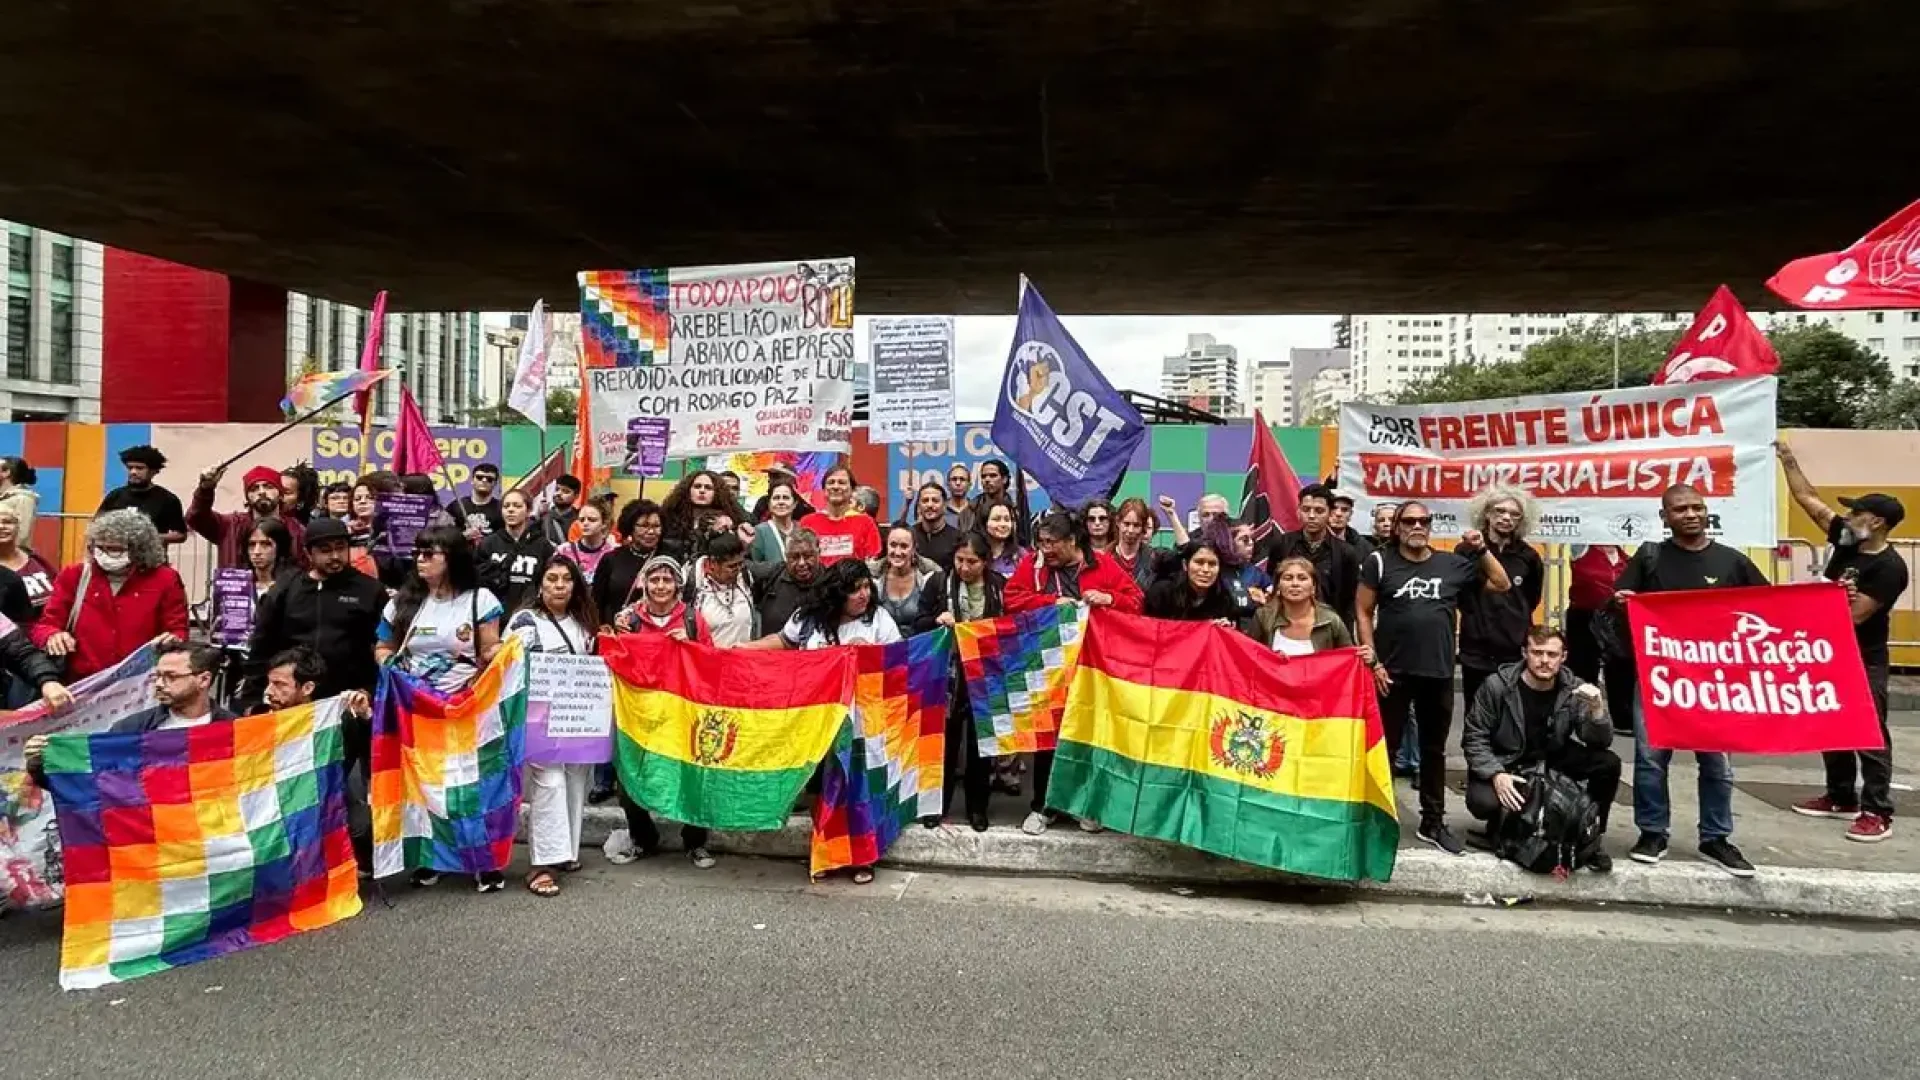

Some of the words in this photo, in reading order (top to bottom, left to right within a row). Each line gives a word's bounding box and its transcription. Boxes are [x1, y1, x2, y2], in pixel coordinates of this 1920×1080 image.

[671, 279, 729, 310] TODO
[729, 273, 800, 307] APOIO
[682, 308, 778, 340] REBELIÃO
[684, 339, 749, 366] ABAIXO
[593, 366, 666, 393] REPÚDIO
[680, 365, 783, 389] CUMPLICIDADE
[793, 368, 809, 381] DE
[639, 395, 679, 416] COM
[687, 391, 757, 412] RODRIGO
[764, 386, 800, 406] PAZ
[696, 418, 741, 435] NOSSA
[755, 421, 810, 437] VERMELHO
[1031, 370, 1127, 464] CST
[1371, 413, 1417, 436] POR
[1418, 407, 1570, 450] FRENTE
[1581, 394, 1725, 443] ÚNICA
[375, 429, 488, 459] Cero
[696, 434, 743, 449] CLASSE
[1368, 431, 1421, 449] UMA
[1373, 455, 1717, 494] ANTI-IMPERIALISTA
[1650, 664, 1841, 716] Socialista
